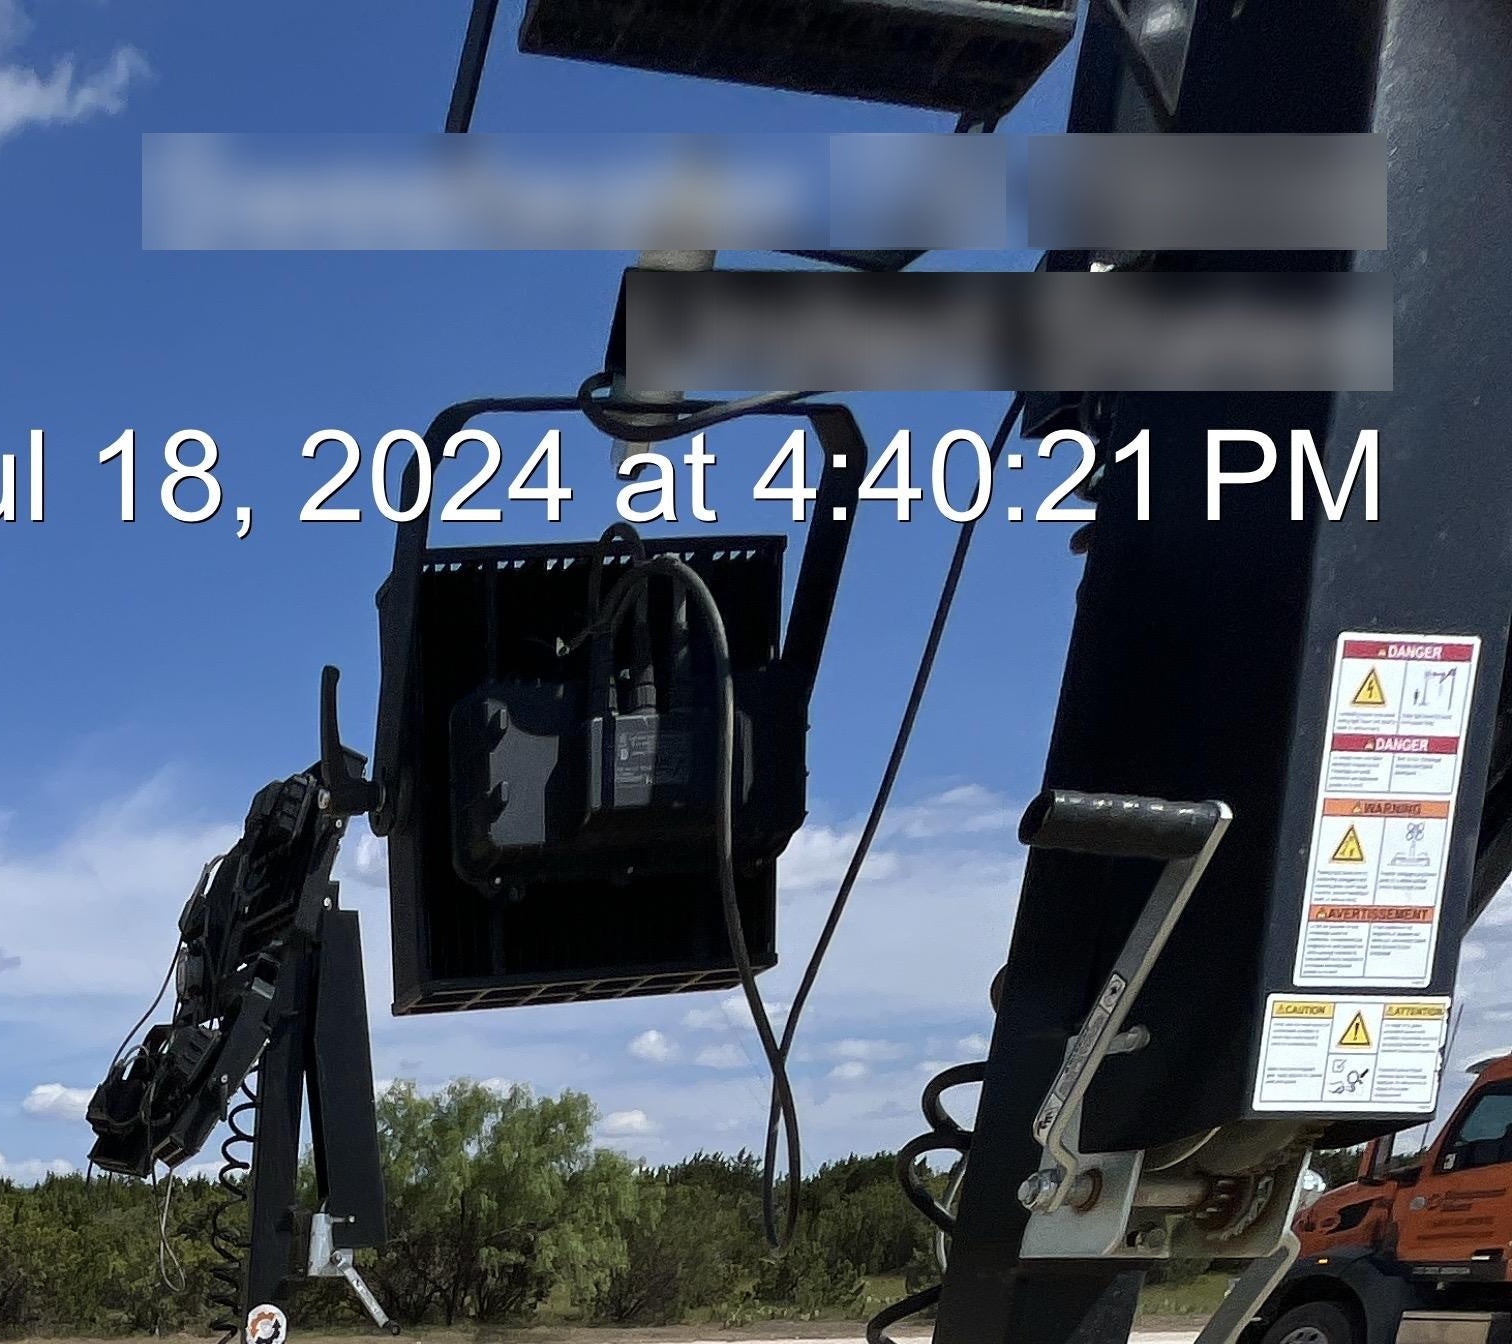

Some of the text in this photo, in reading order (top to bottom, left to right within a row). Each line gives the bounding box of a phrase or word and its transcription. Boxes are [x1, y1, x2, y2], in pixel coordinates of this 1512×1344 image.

[1387, 644, 1443, 659] DANGER
[1374, 738, 1429, 752] DANGER
[1363, 803, 1422, 815] WARNING
[1327, 907, 1429, 920] AVERTISSEMENT
[1284, 1005, 1326, 1015] CAUTION
